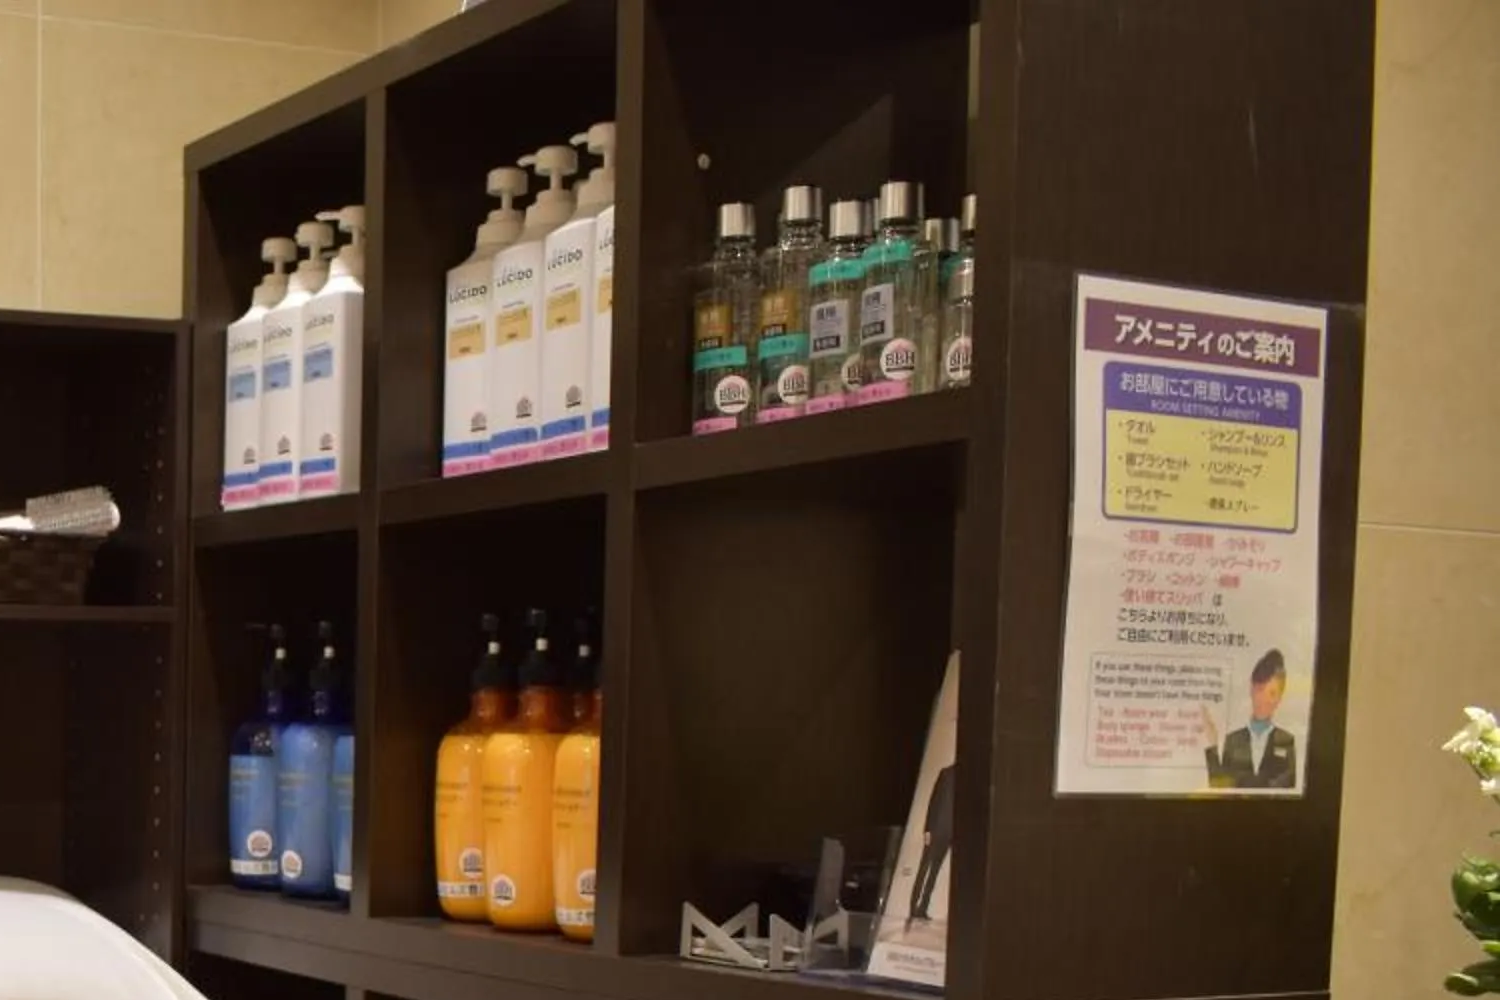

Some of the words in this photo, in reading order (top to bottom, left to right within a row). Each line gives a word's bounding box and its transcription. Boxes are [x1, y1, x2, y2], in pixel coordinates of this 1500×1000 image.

[1114, 313, 1295, 367] アメニティのご案内
[1120, 371, 1289, 411] お部屋にご用意している物
[1212, 593, 1222, 606] は
